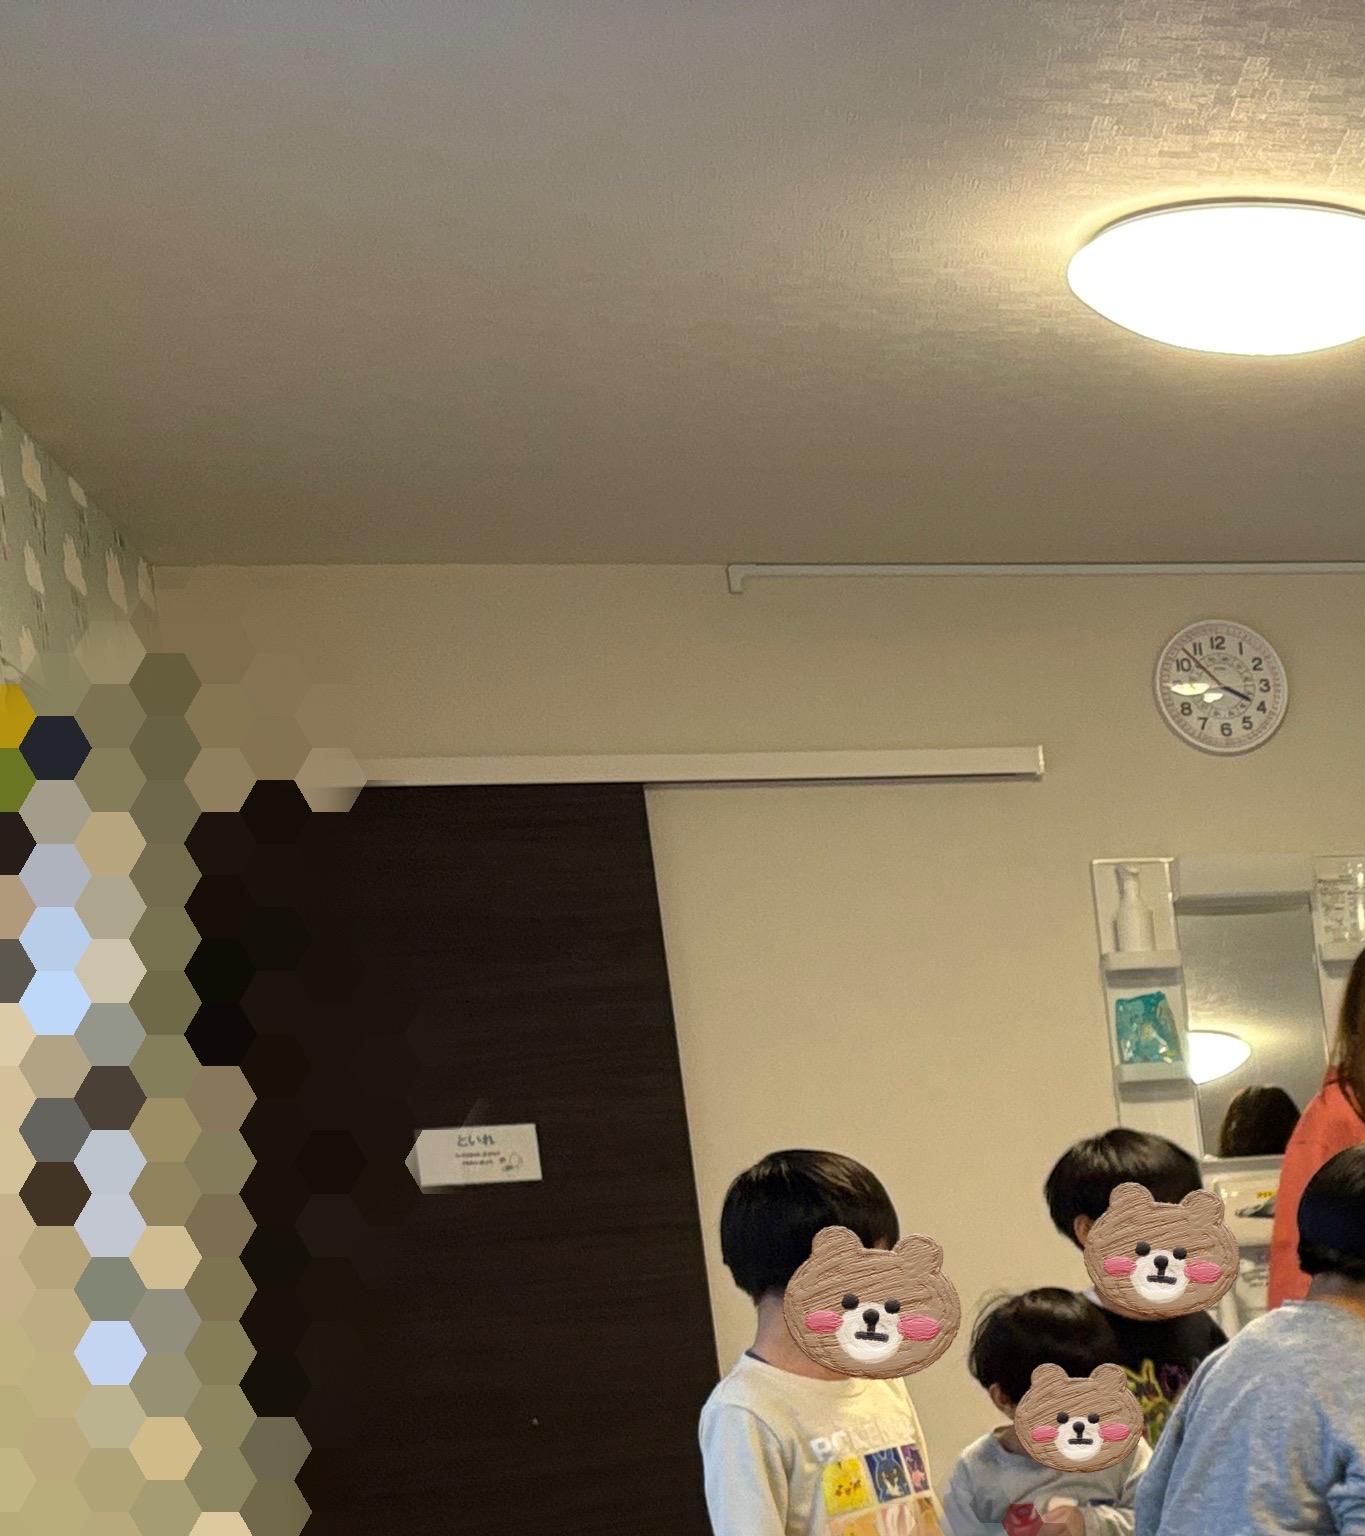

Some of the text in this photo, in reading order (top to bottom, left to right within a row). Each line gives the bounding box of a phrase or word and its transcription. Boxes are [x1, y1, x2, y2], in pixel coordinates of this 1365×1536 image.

[1193, 642, 1203, 656] 11
[1210, 636, 1226, 650] 12
[1238, 642, 1244, 655] 1
[1176, 658, 1192, 672] 10
[1252, 657, 1263, 671] 2
[1259, 678, 1271, 693] 3
[1180, 702, 1193, 716] 8
[1256, 701, 1267, 714] 4
[1198, 717, 1209, 730] 7
[1220, 723, 1233, 737] 6
[1242, 716, 1253, 730] 5
[457, 1134, 495, 1147] といれ
